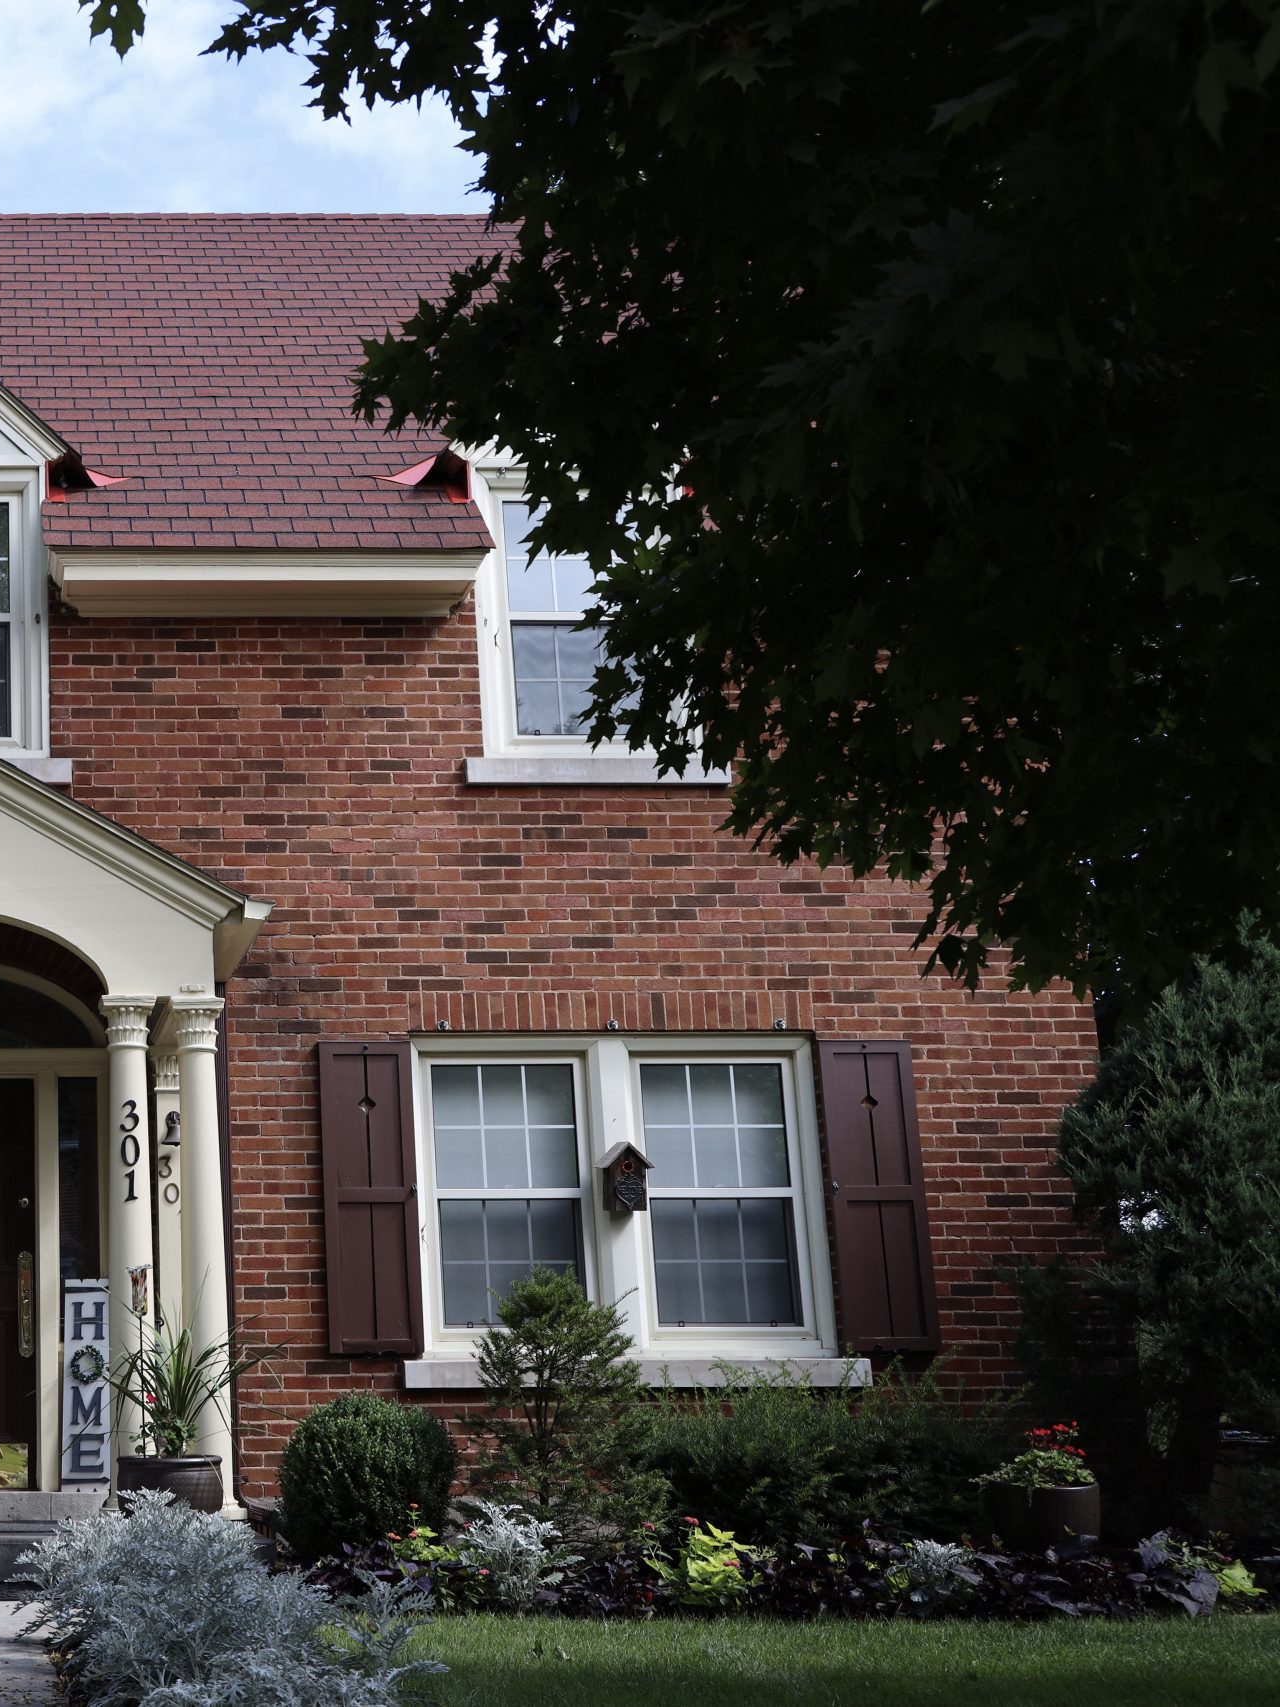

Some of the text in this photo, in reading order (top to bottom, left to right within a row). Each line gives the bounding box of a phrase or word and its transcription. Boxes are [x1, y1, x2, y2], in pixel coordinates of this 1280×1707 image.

[119, 1099, 140, 1203] 301
[158, 1155, 181, 1215] 30
[70, 1301, 106, 1473] HOME
